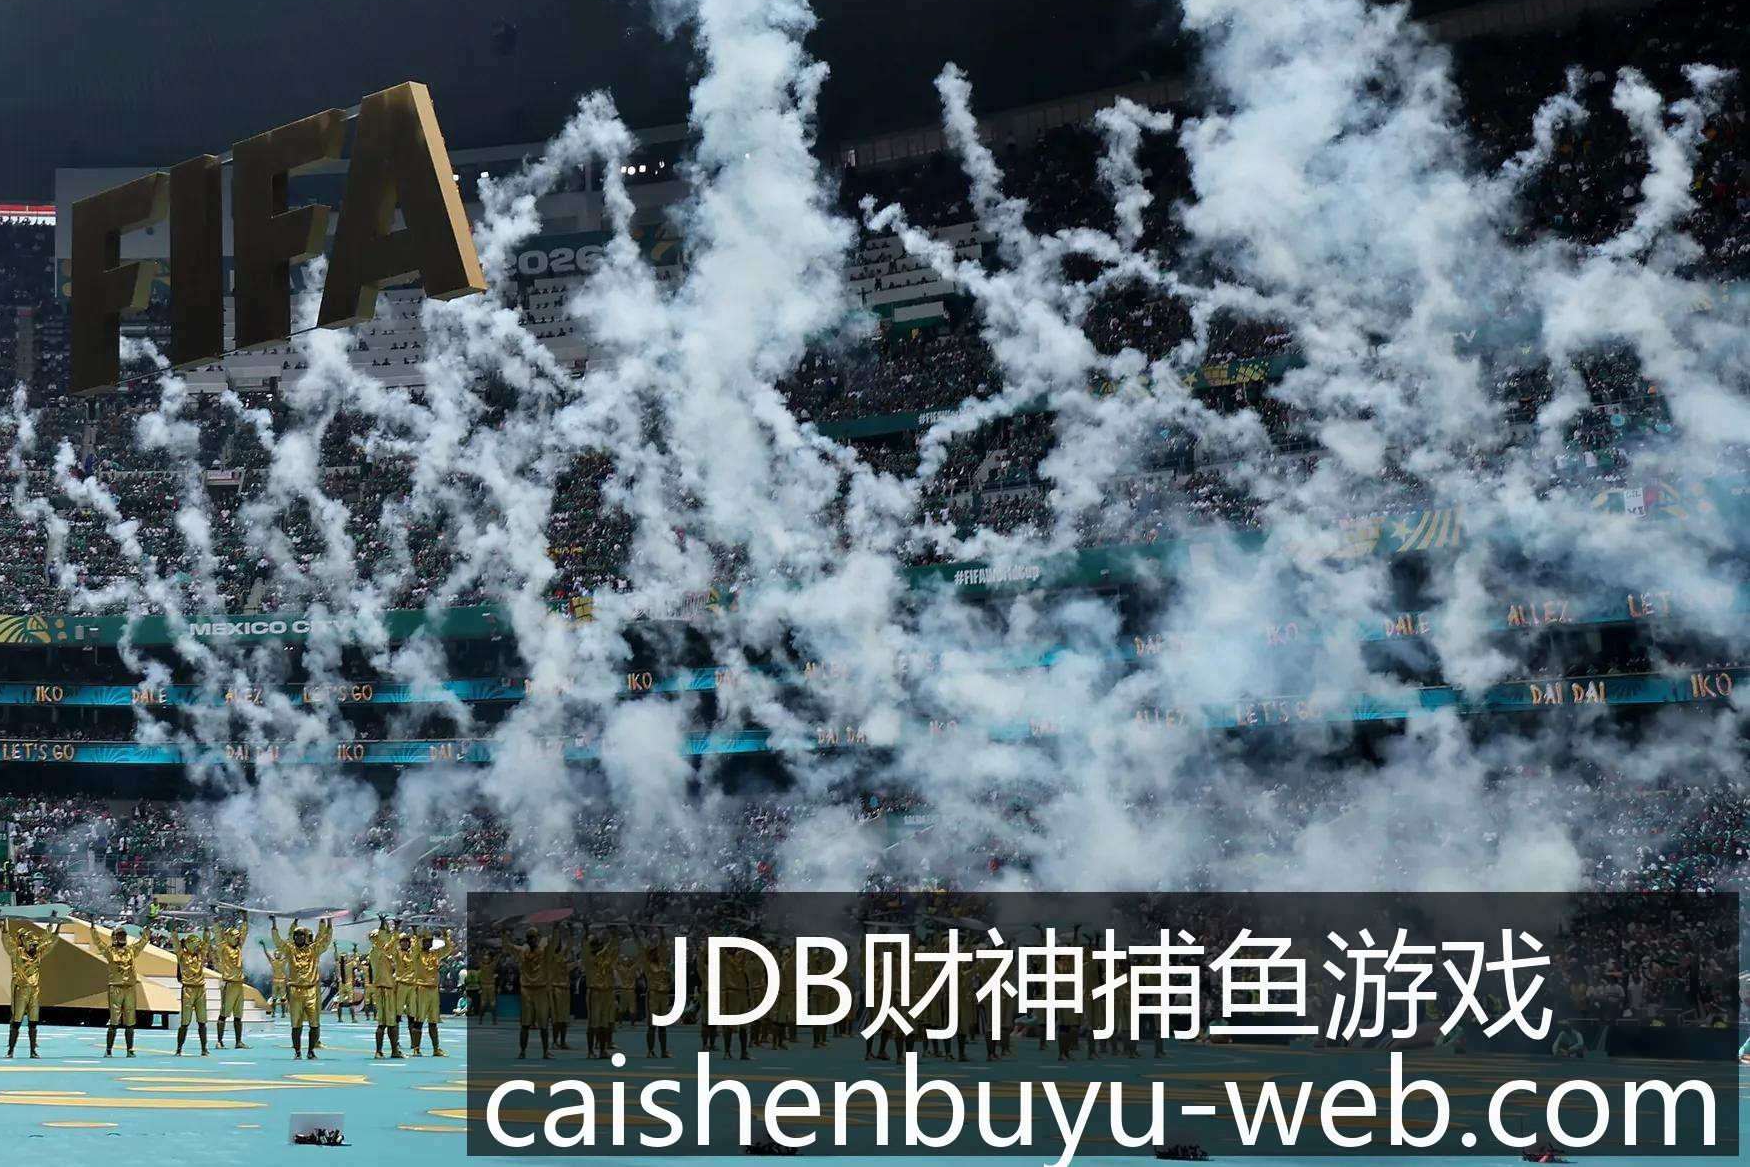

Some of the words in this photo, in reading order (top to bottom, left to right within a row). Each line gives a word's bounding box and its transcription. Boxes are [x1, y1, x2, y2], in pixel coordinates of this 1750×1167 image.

[69, 81, 488, 396] FIFA
[189, 620, 288, 635] MEXICO
[627, 672, 653, 692] IKO
[1690, 671, 1735, 698] IKO
[35, 685, 64, 702] IKO
[351, 684, 373, 702] GO
[1530, 682, 1564, 705] DAI
[1571, 680, 1607, 705] DAI
[2, 743, 48, 761] LET'S
[53, 743, 75, 760] GO
[337, 744, 365, 761] IKO
